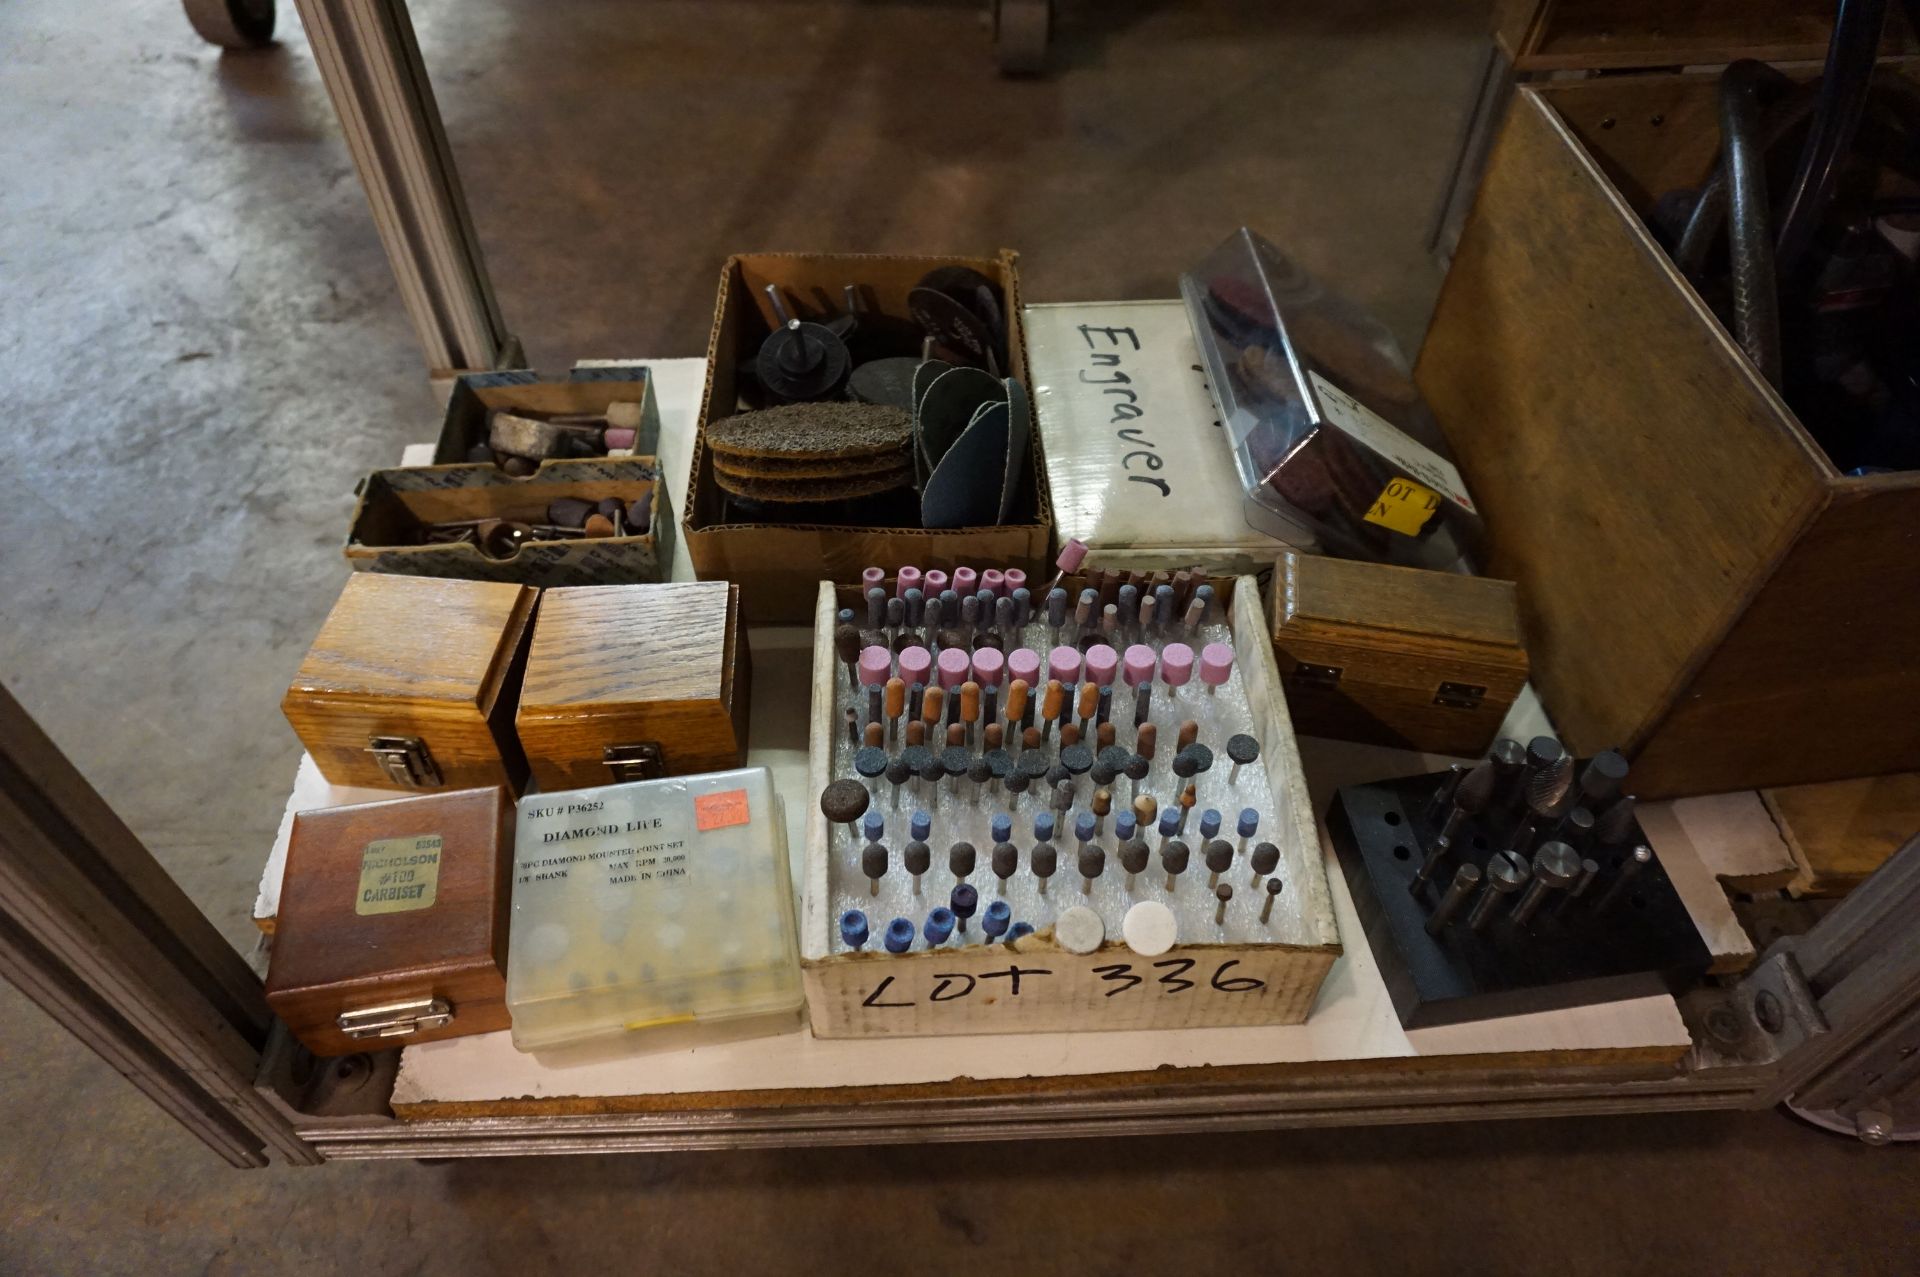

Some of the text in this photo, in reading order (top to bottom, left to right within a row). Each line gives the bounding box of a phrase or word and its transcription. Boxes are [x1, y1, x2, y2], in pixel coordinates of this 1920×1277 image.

[1077, 324, 1171, 497] Engraver
[527, 801, 604, 820] SKU # P36252
[543, 825, 619, 843] DIAMOND
[363, 852, 438, 871] NICHOLSON
[542, 855, 586, 867] DIAMOND
[588, 848, 633, 861] MOUNTED
[667, 840, 684, 849] SET
[379, 870, 415, 885] #100
[535, 869, 568, 881] SHANK
[608, 875, 637, 886] MADE
[641, 872, 652, 881] IN
[363, 883, 426, 902] CARBISET
[1092, 958, 1266, 997] 336
